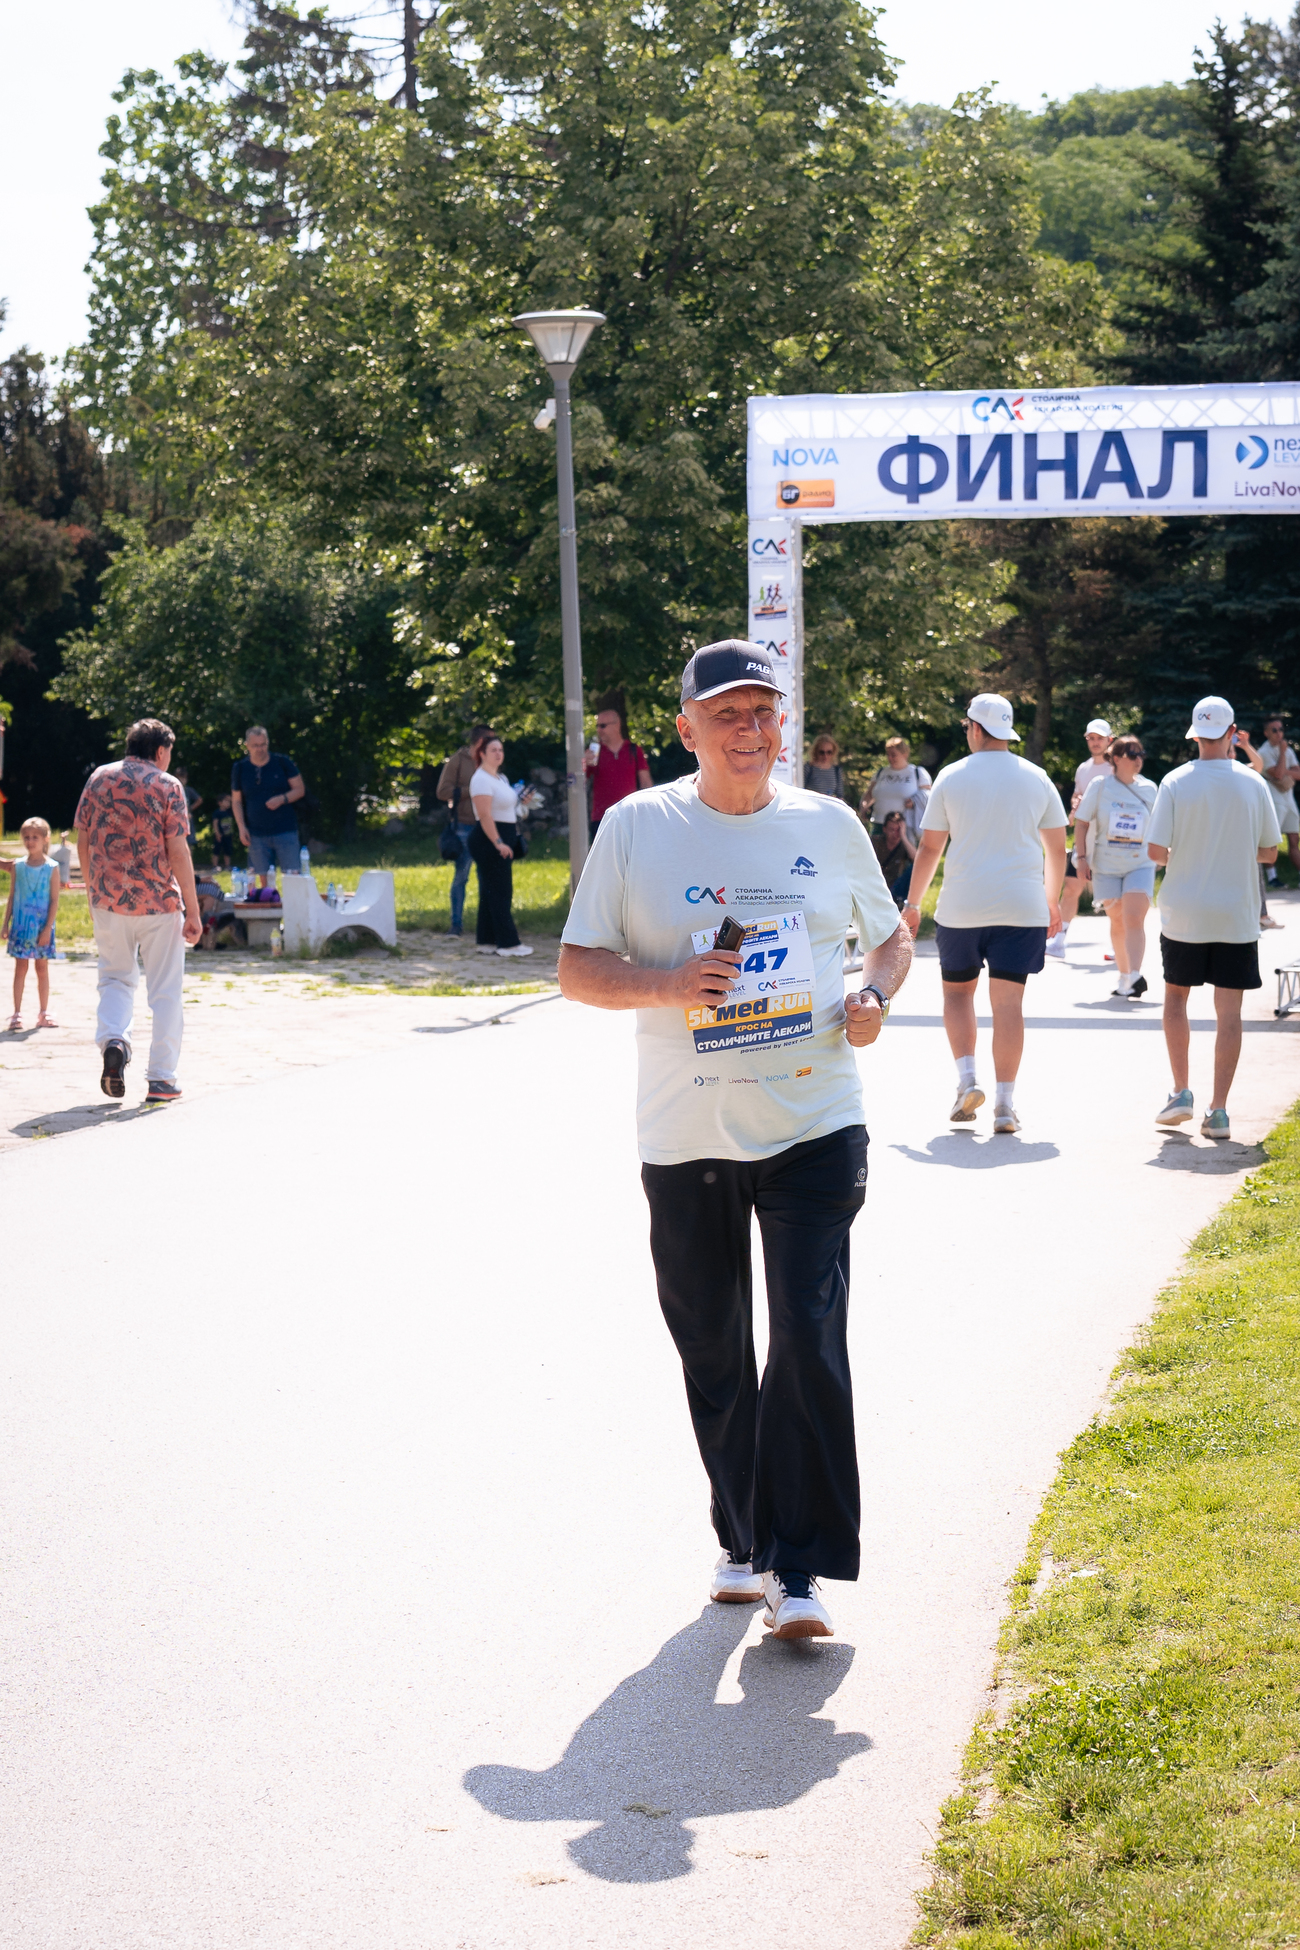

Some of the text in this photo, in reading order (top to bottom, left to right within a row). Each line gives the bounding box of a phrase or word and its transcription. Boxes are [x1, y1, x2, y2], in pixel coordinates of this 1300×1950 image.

[773, 447, 840, 467] NOVA
[877, 430, 1209, 504] ФИНАЛ
[734, 947, 788, 974] 47
[697, 1021, 811, 1051] СТОЛИЧНИТЕ ЛЕКАРИ
[735, 1021, 773, 1033] КРОС НА
[740, 1045, 772, 1054] powered
[766, 1074, 789, 1082] NOVA
